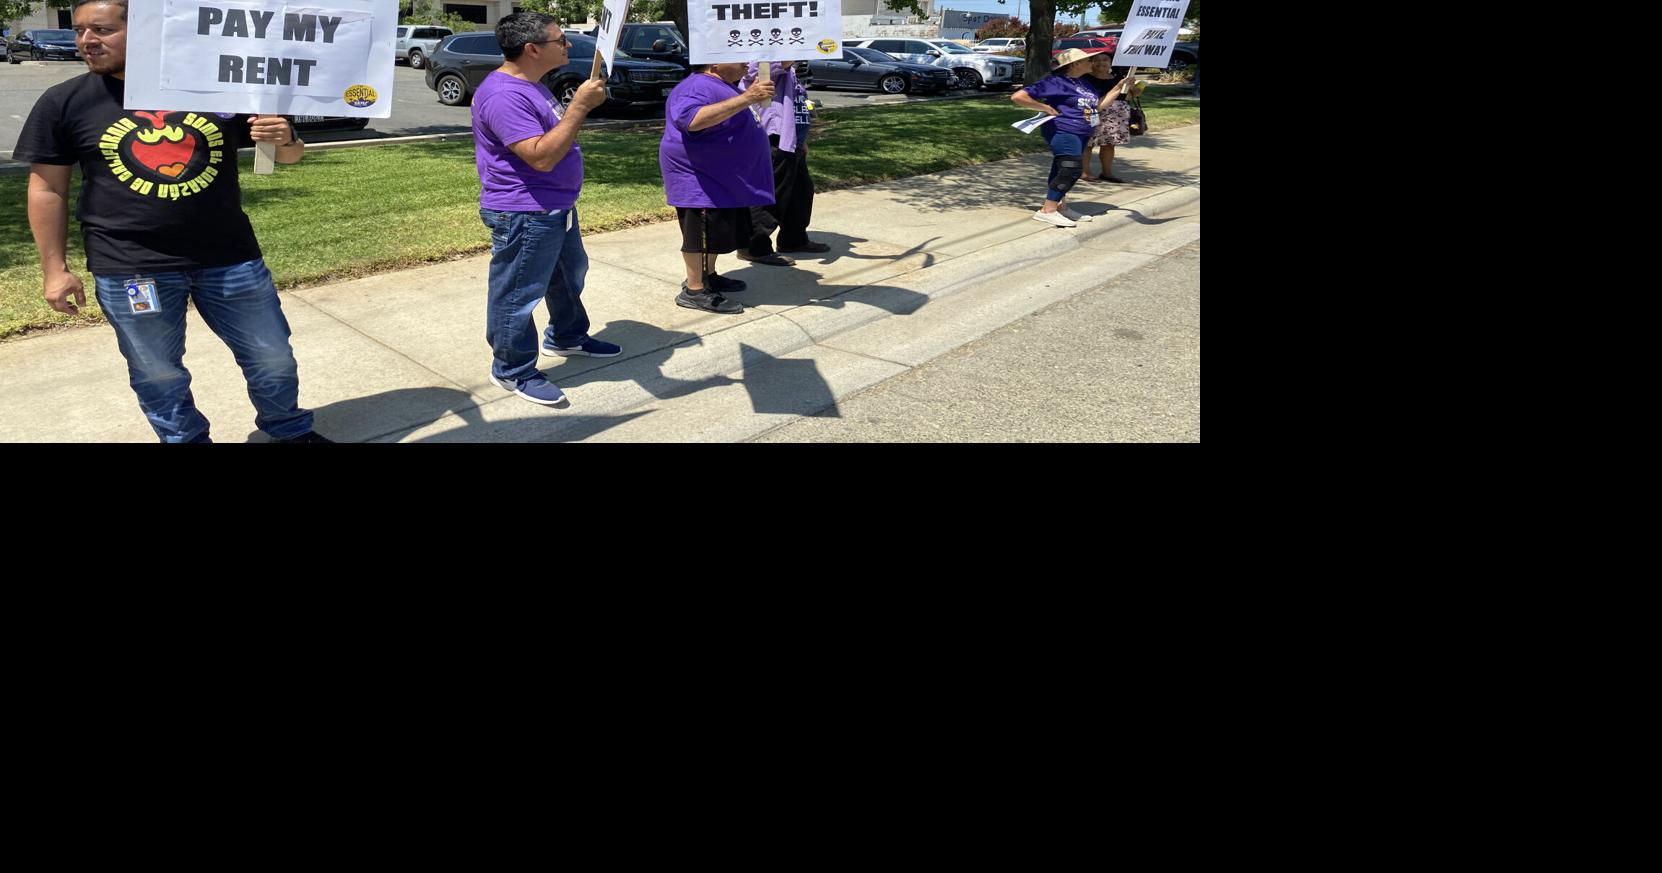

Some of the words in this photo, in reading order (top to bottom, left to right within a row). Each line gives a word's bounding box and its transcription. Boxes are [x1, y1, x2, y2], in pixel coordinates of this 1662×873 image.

[712, 1, 818, 20] THEFT!
[1136, 6, 1181, 18] ESSENTIAL
[197, 6, 275, 39] PAY
[282, 12, 343, 43] MY
[1143, 45, 1167, 56] WAY
[218, 54, 317, 87] RENT
[183, 112, 224, 148] SOMOS
[99, 117, 138, 182] CALIFORNIA
[209, 150, 223, 164] EL
[129, 177, 154, 195] DE
[157, 165, 219, 201] CORAZÓN
